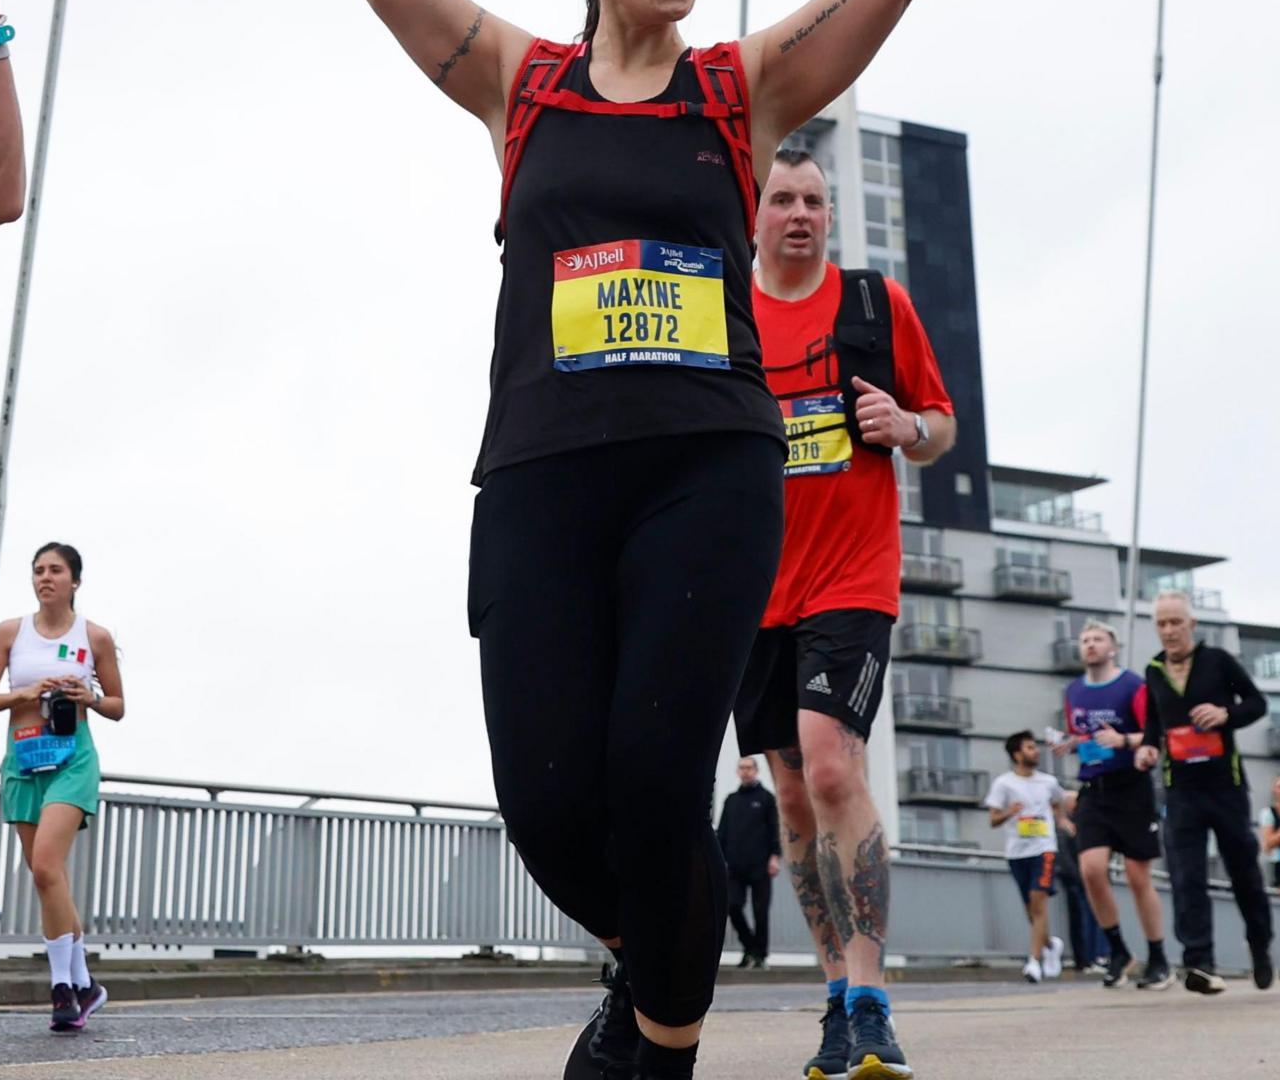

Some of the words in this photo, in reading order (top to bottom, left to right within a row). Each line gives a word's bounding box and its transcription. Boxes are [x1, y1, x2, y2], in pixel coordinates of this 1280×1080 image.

[582, 248, 624, 270] AJBell
[597, 277, 683, 310] MAXINE
[604, 311, 680, 344] 12872
[605, 353, 627, 364] HALF
[629, 351, 681, 362] MARATHON
[786, 441, 820, 462] 870
[806, 683, 832, 695] adidas
